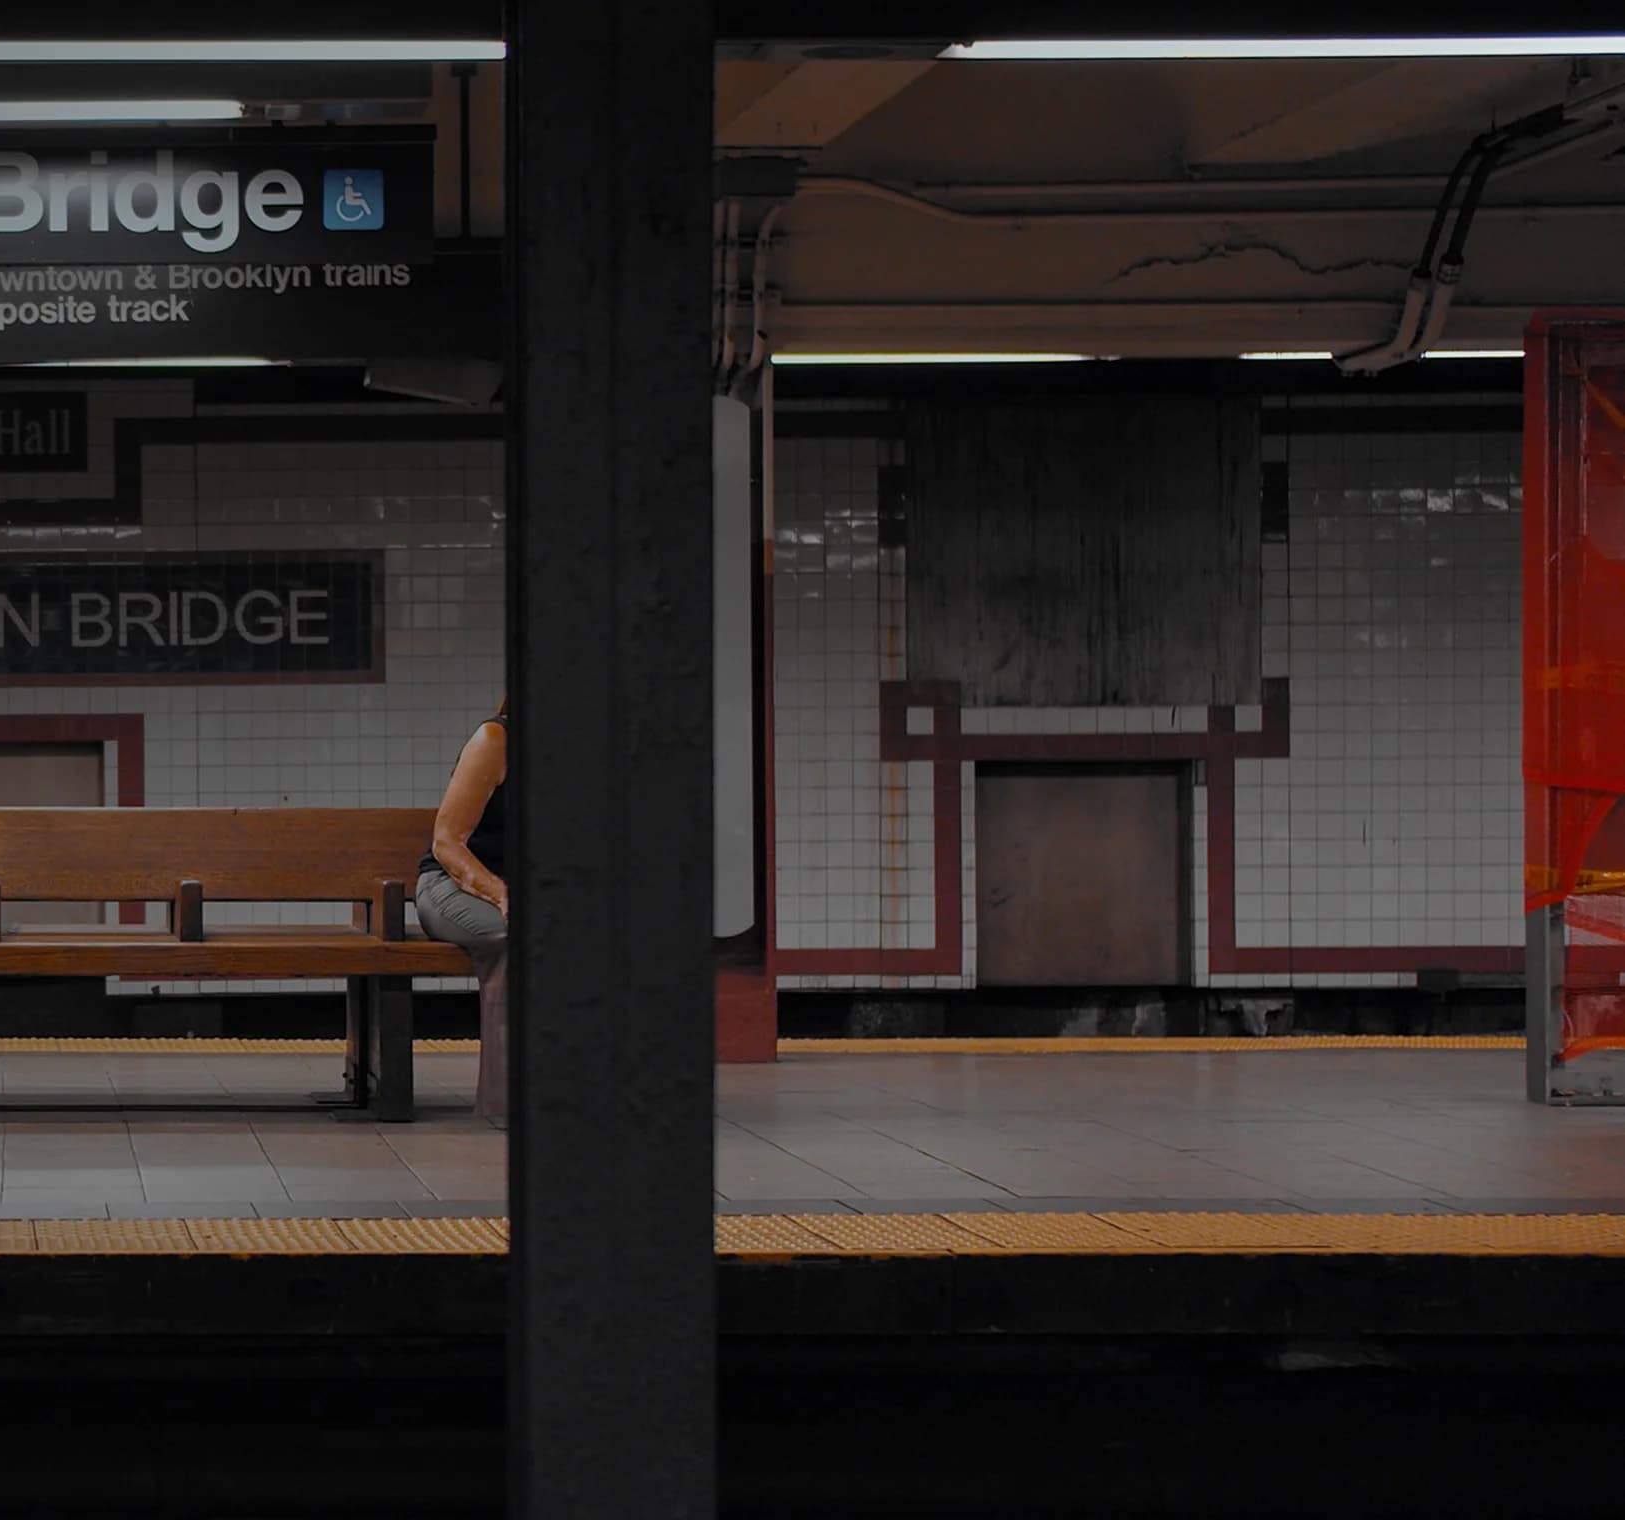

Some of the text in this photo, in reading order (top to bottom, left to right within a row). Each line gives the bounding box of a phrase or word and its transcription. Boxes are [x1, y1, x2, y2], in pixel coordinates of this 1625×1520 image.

[133, 266, 157, 291] &
[168, 264, 311, 294] Brooklyn
[322, 262, 412, 289] trains
[106, 294, 190, 322] track
[70, 589, 330, 648] BRIDGE
